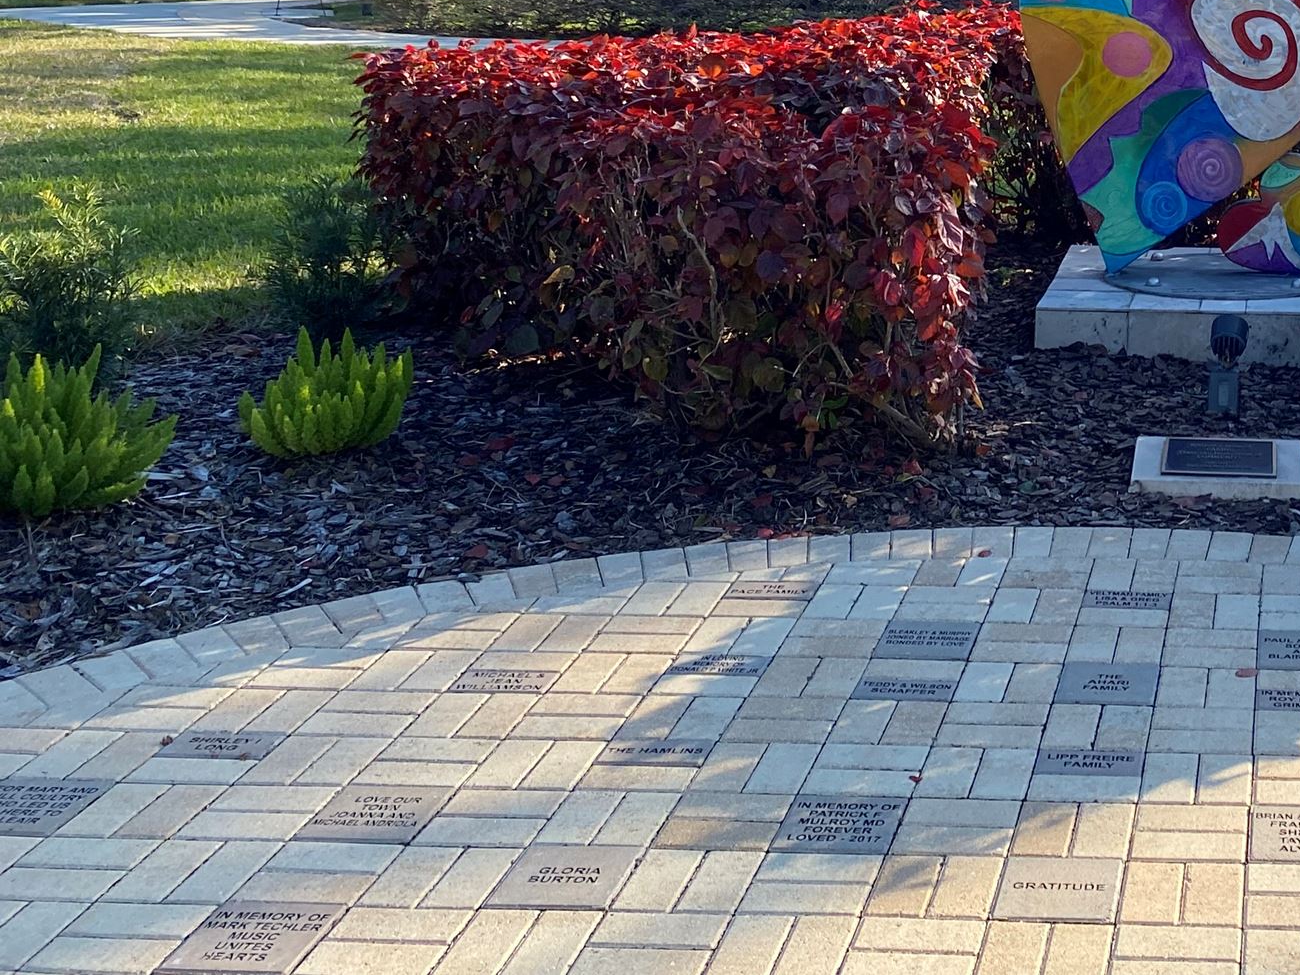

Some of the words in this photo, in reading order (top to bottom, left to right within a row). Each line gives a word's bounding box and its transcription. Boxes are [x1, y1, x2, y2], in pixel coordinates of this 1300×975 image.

[818, 802, 875, 810] MEMORY
[809, 810, 868, 818] PATRICK
[798, 818, 860, 826] MULROY
[803, 826, 872, 834] FOREVER
[787, 834, 836, 842] LOVED
[528, 875, 598, 883] BURTON
[1013, 882, 1105, 891] GRATITUDE
[215, 911, 233, 919] IN
[237, 912, 306, 921] MEMORY
[308, 914, 331, 922] OF
[204, 921, 248, 930] MARK
[253, 922, 323, 932] TECHLER
[228, 931, 280, 941] MUSIC
[215, 941, 274, 952] UNITES
[202, 952, 268, 962] HEARTS
